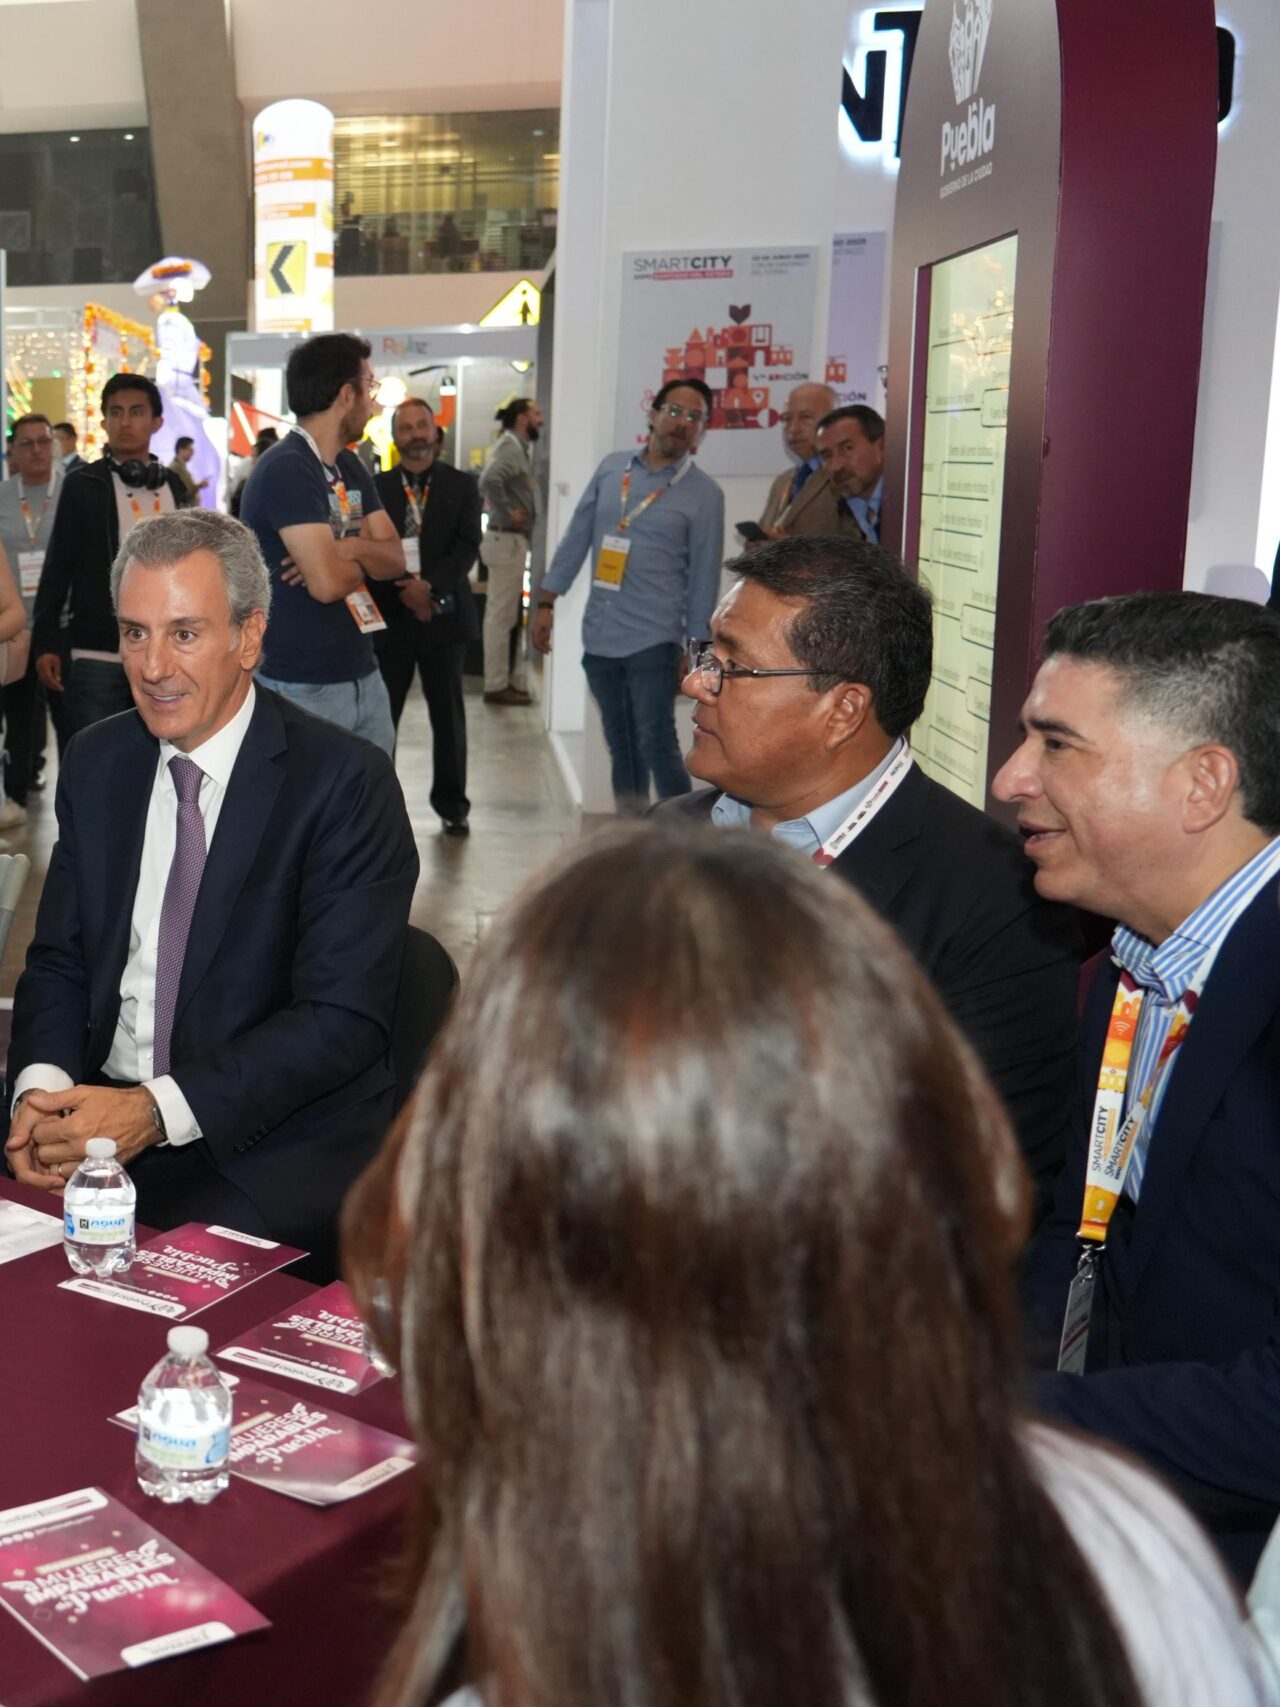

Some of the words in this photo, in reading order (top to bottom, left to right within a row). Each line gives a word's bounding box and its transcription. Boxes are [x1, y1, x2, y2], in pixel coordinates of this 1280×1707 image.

[633, 255, 732, 273] SMARTCITY
[1091, 1105, 1109, 1173] SMARTCITY
[1104, 1115, 1135, 1178] SMARTCITY
[267, 1426, 343, 1465] Puebla
[23, 1552, 176, 1606] IMPARABLES
[35, 1549, 140, 1588] MUJERES
[65, 1571, 180, 1614] Puebla
